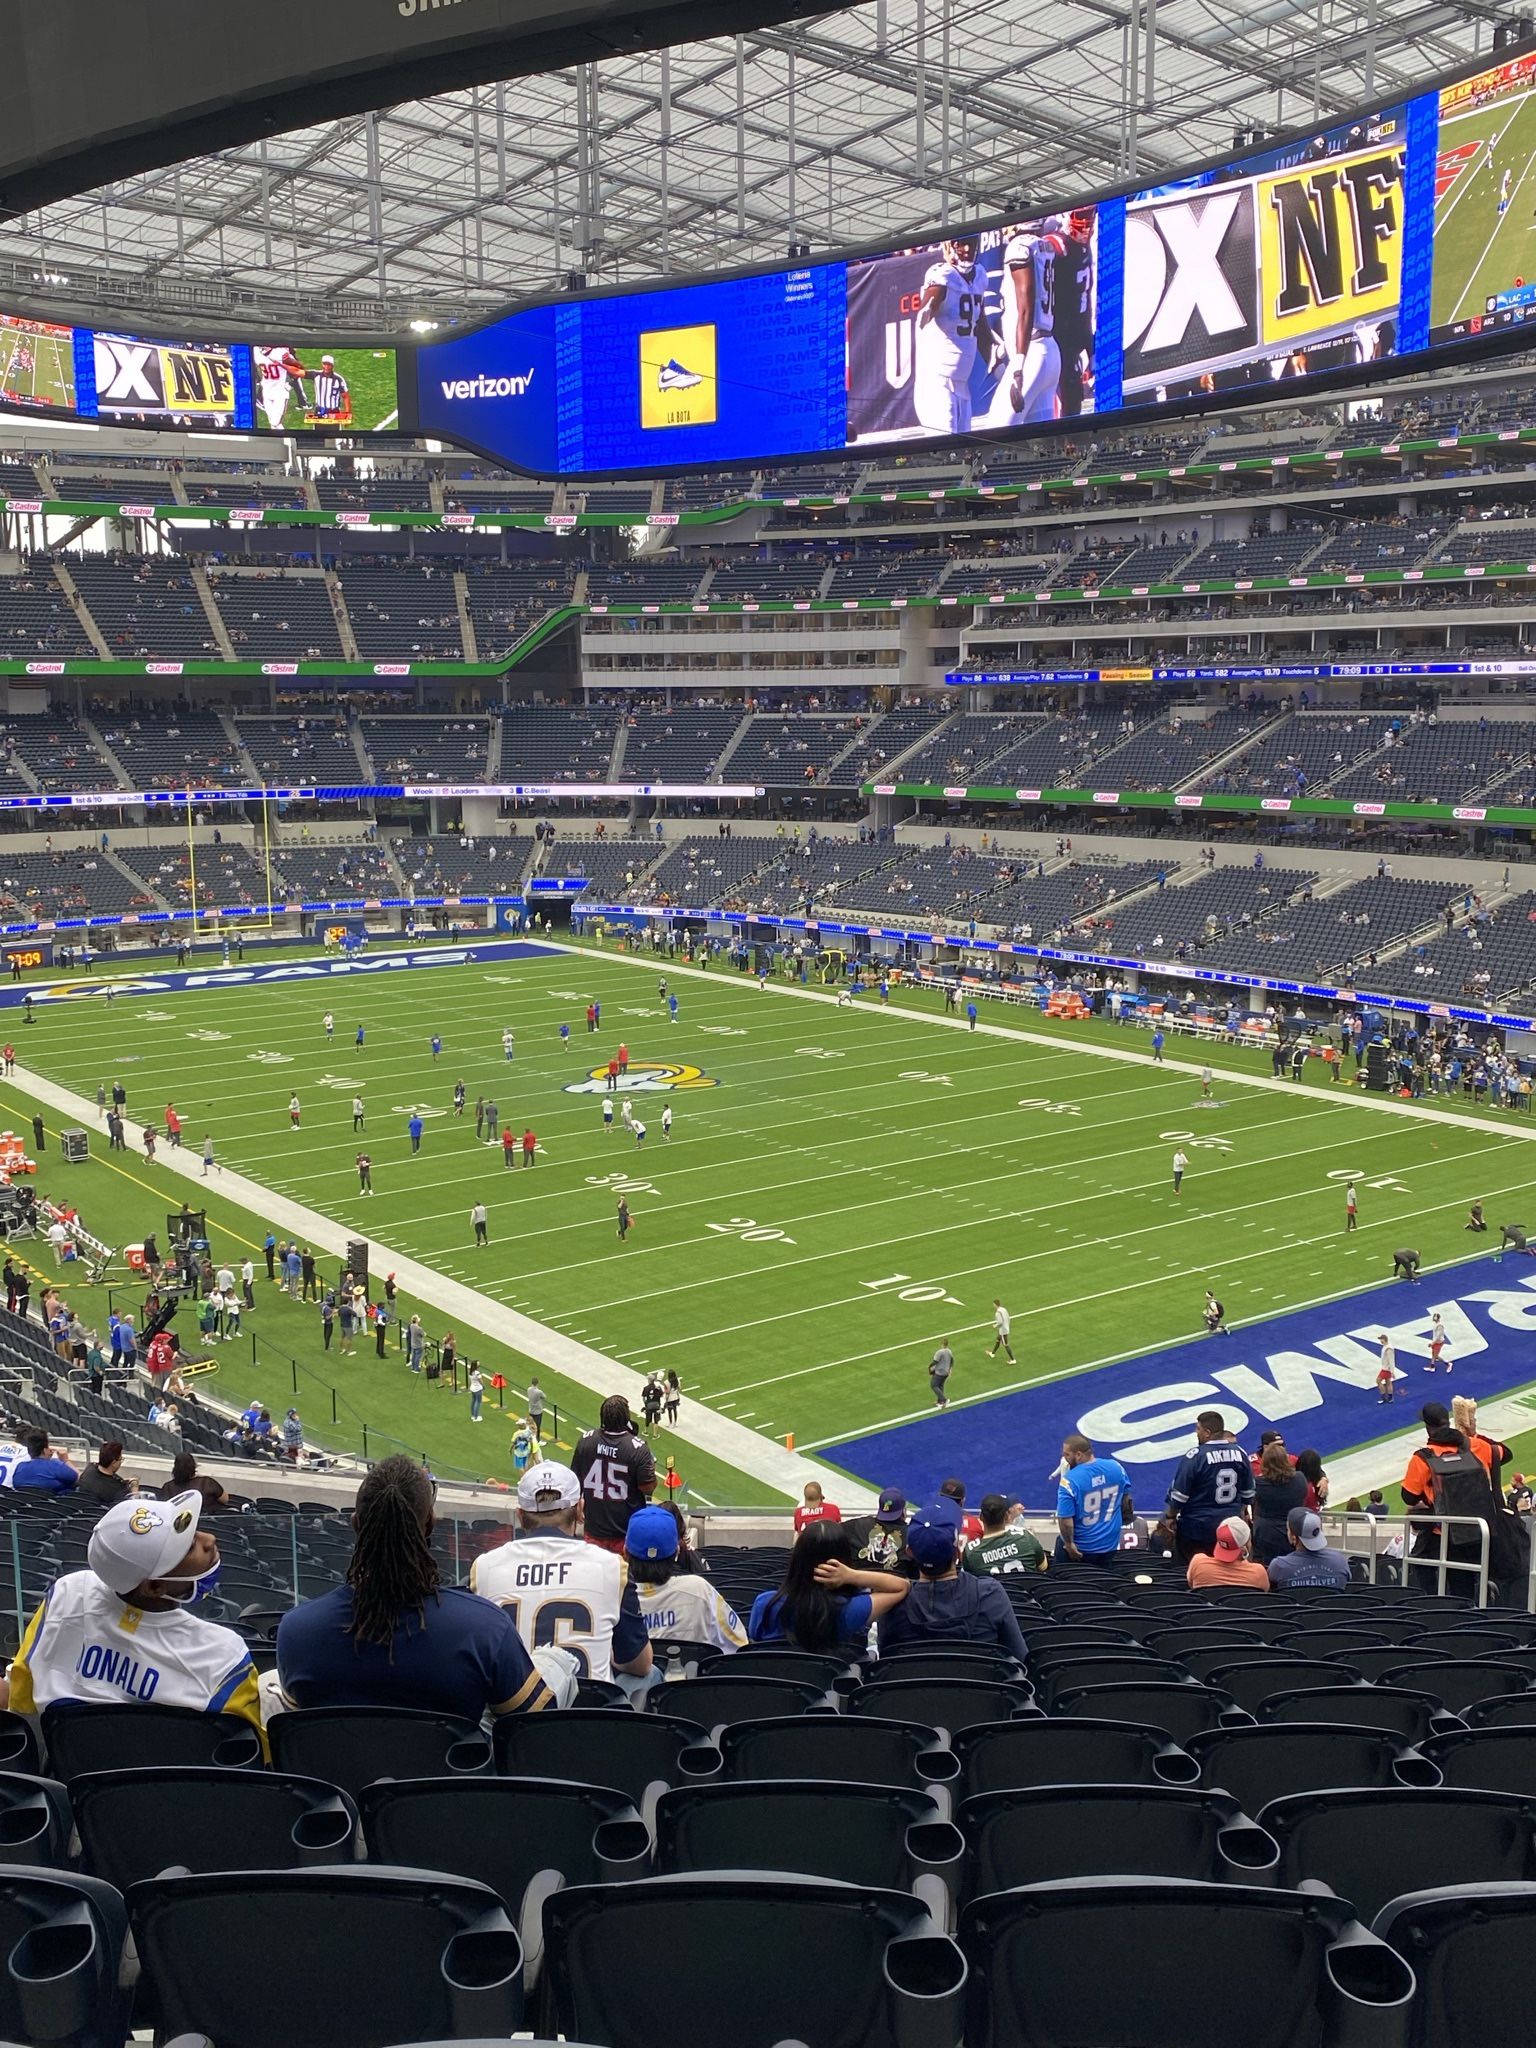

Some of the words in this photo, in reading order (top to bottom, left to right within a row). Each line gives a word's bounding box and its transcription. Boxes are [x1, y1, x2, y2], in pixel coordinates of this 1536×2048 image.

[785, 282, 814, 293] Winners
[1508, 294, 1521, 303] LAC
[441, 374, 525, 399] verizon
[667, 412, 674, 424] LA
[676, 411, 690, 423] BOTA
[14, 502, 40, 511] Castrol
[127, 507, 153, 516] Castrol
[237, 511, 262, 520] Castrol
[342, 513, 368, 524] Castrol
[449, 516, 474, 524] Castrol
[551, 517, 576, 525] Castrol
[653, 516, 678, 525] Castrol
[35, 663, 62, 673] Castrol
[155, 664, 181, 673] Castrol
[270, 664, 296, 673] Castrol
[382, 665, 407, 674] Castrol
[1486, 664, 1492, 672] &
[1493, 664, 1502, 672] 10
[999, 674, 1011, 682] 638
[1102, 672, 1125, 680] Passing
[1129, 671, 1151, 679] Season
[1099, 793, 1119, 802] Castrol
[1181, 796, 1202, 805] Castrol
[1267, 799, 1291, 809] Castrol
[1361, 804, 1385, 814] Castrol
[1460, 808, 1486, 819] Castrol
[330, 928, 345, 941] 25
[185, 951, 477, 986] RAMS
[1017, 1098, 1082, 1115] 30
[1158, 1131, 1234, 1149] 20
[584, 1172, 653, 1193] 30
[1326, 1169, 1400, 1190] 10
[705, 1217, 785, 1242] 20
[132, 1253, 142, 1264] G
[858, 1273, 947, 1302] 10
[597, 1443, 619, 1458] WHITE
[1206, 1449, 1243, 1465] AIKMAN
[583, 1459, 629, 1501] 45
[1214, 1468, 1238, 1505] 8
[800, 1506, 824, 1516] BRADY
[1082, 1485, 1120, 1526] 97
[981, 1543, 1019, 1564] RODGERS
[515, 1562, 573, 1586] GOFF
[77, 1642, 160, 1701] ONALD
